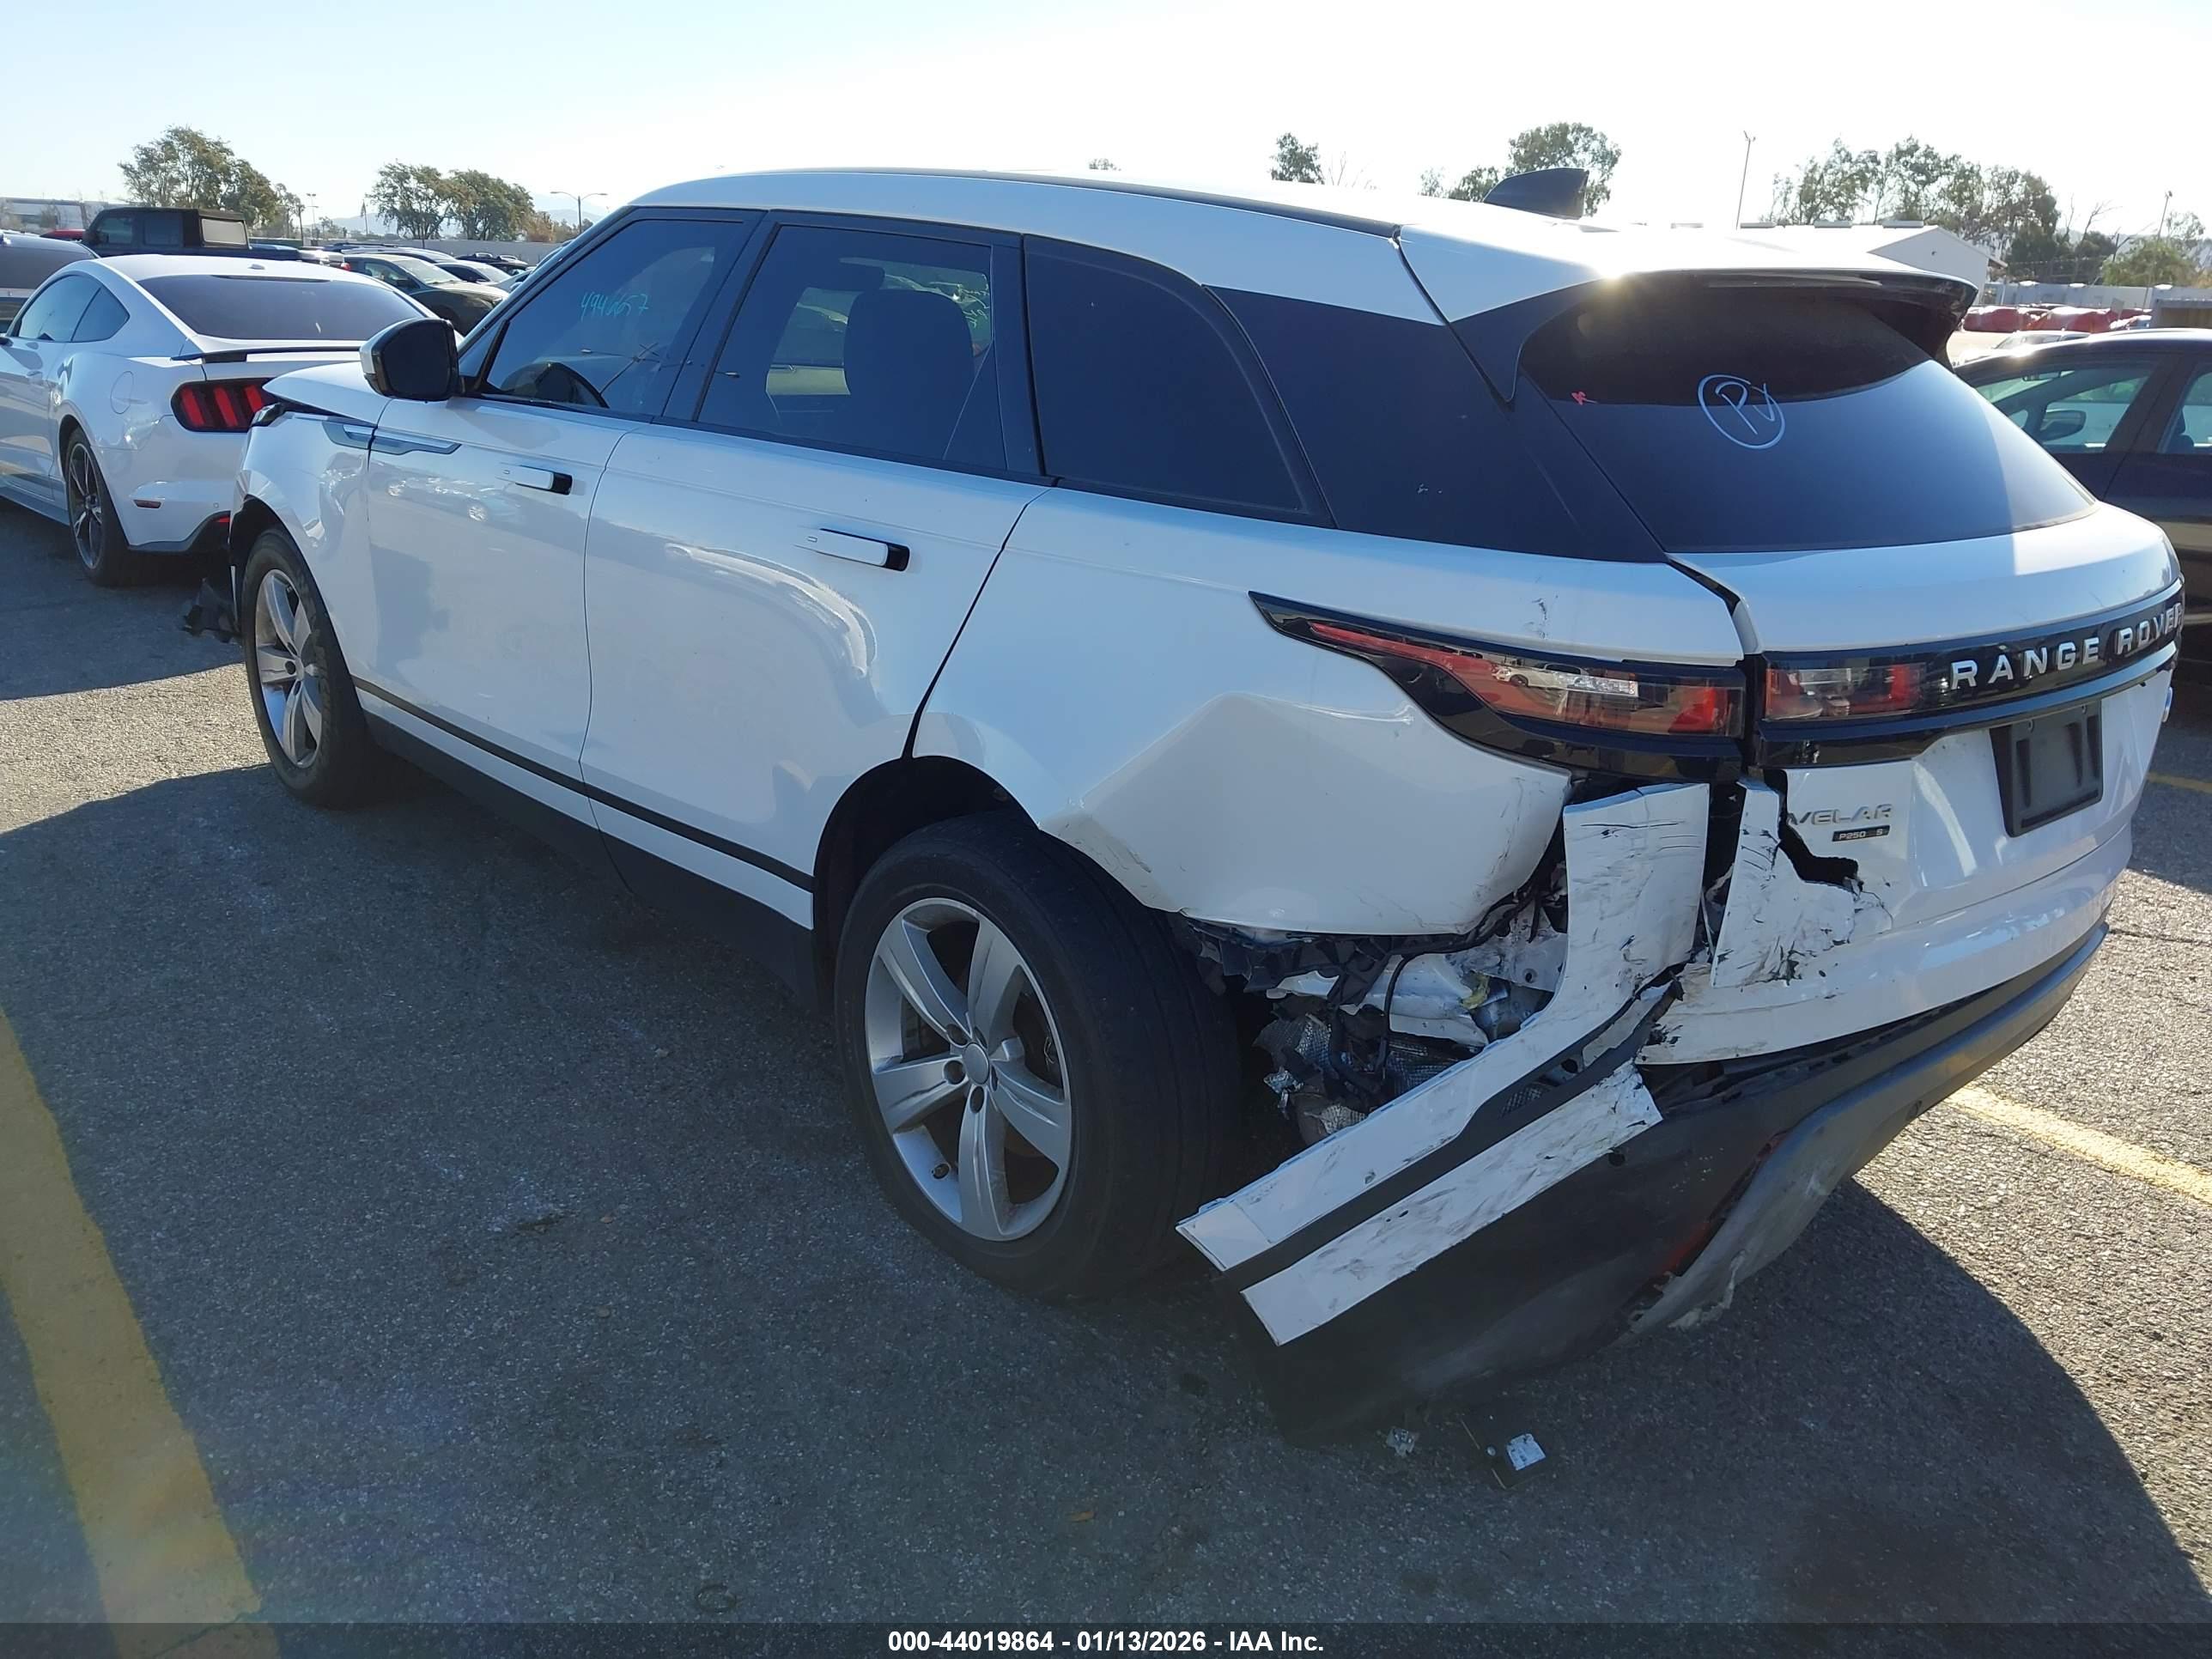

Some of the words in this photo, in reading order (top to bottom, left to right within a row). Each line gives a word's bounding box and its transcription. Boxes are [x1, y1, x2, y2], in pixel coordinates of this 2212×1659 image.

[1950, 637, 2100, 690] RANGE
[2116, 603, 2183, 655] ROVER
[1787, 804, 1893, 826] VELAR
[1838, 830, 1866, 841] P250
